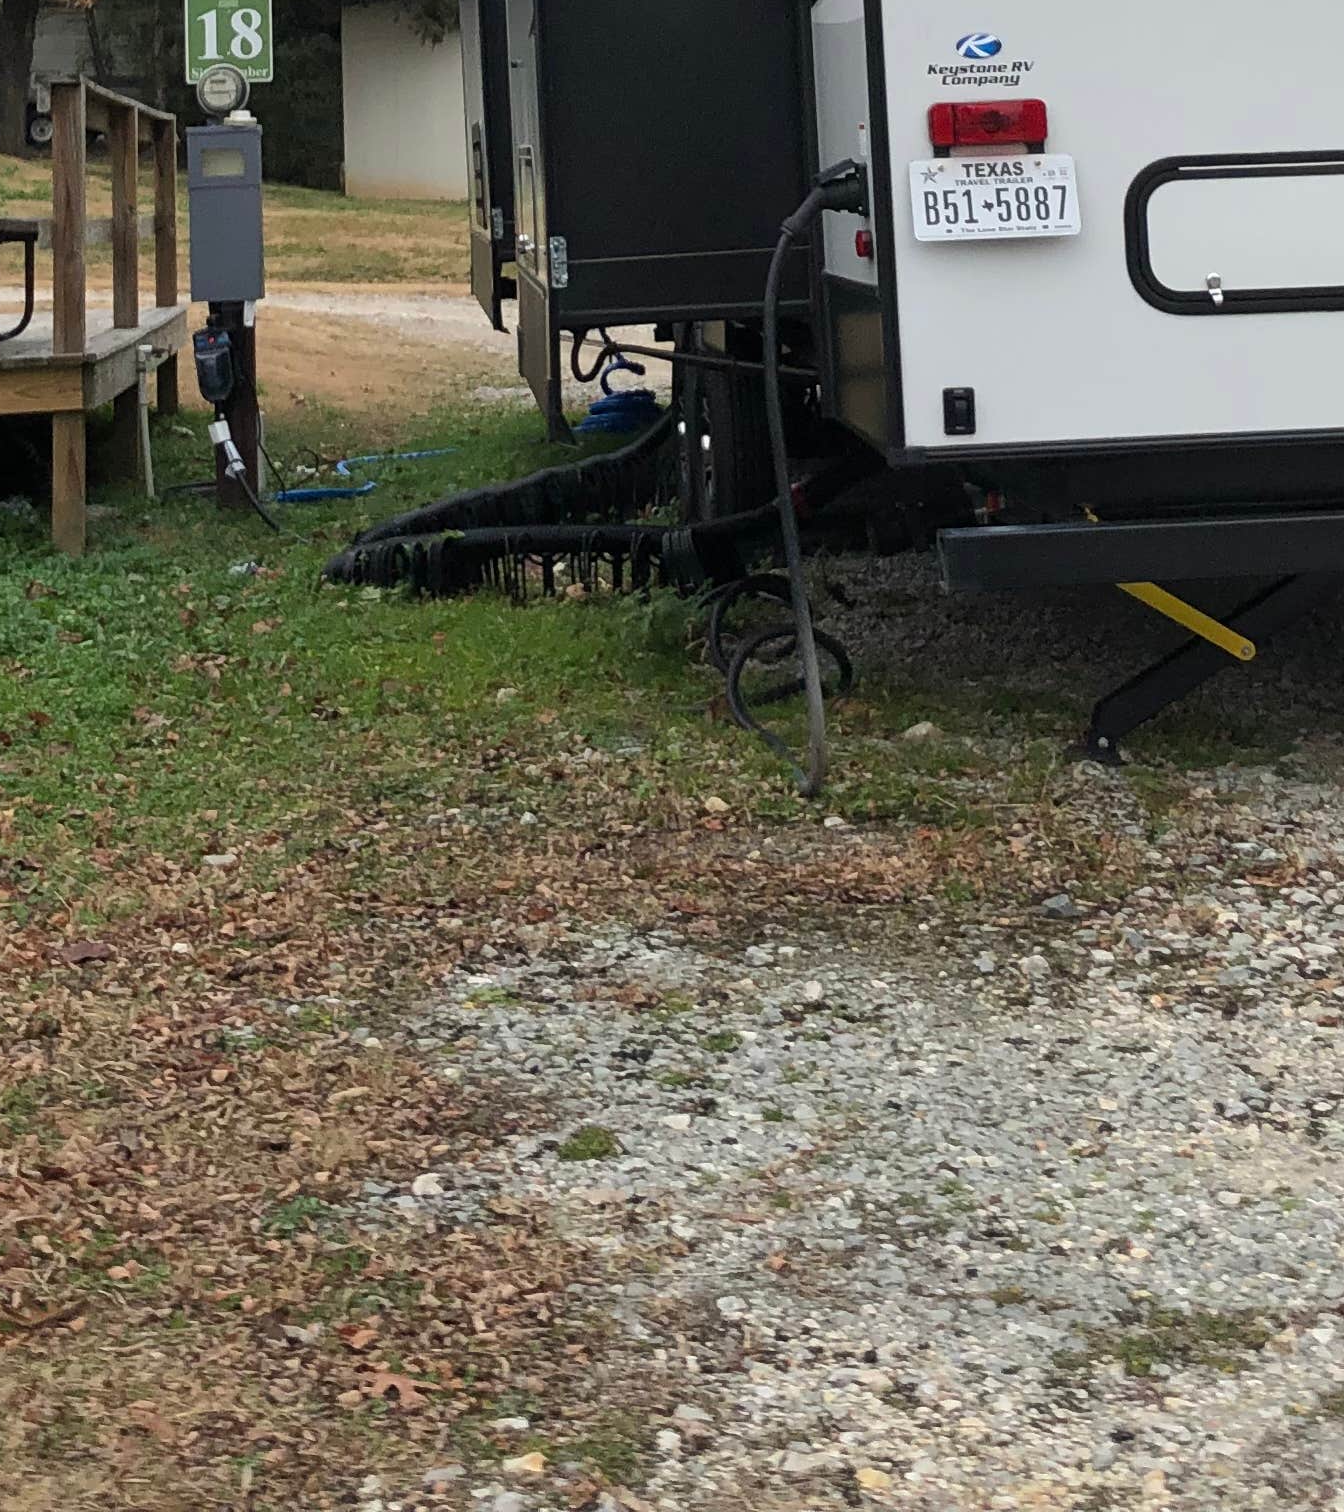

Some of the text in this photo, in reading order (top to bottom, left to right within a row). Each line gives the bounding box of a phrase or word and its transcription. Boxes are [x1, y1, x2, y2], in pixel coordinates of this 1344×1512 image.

[196, 8, 263, 60] 18
[927, 61, 1034, 76] Keystone RV
[942, 75, 1021, 87] Company
[961, 161, 1024, 178] TEXAS
[954, 176, 1034, 187] TRAVEL TRAILER
